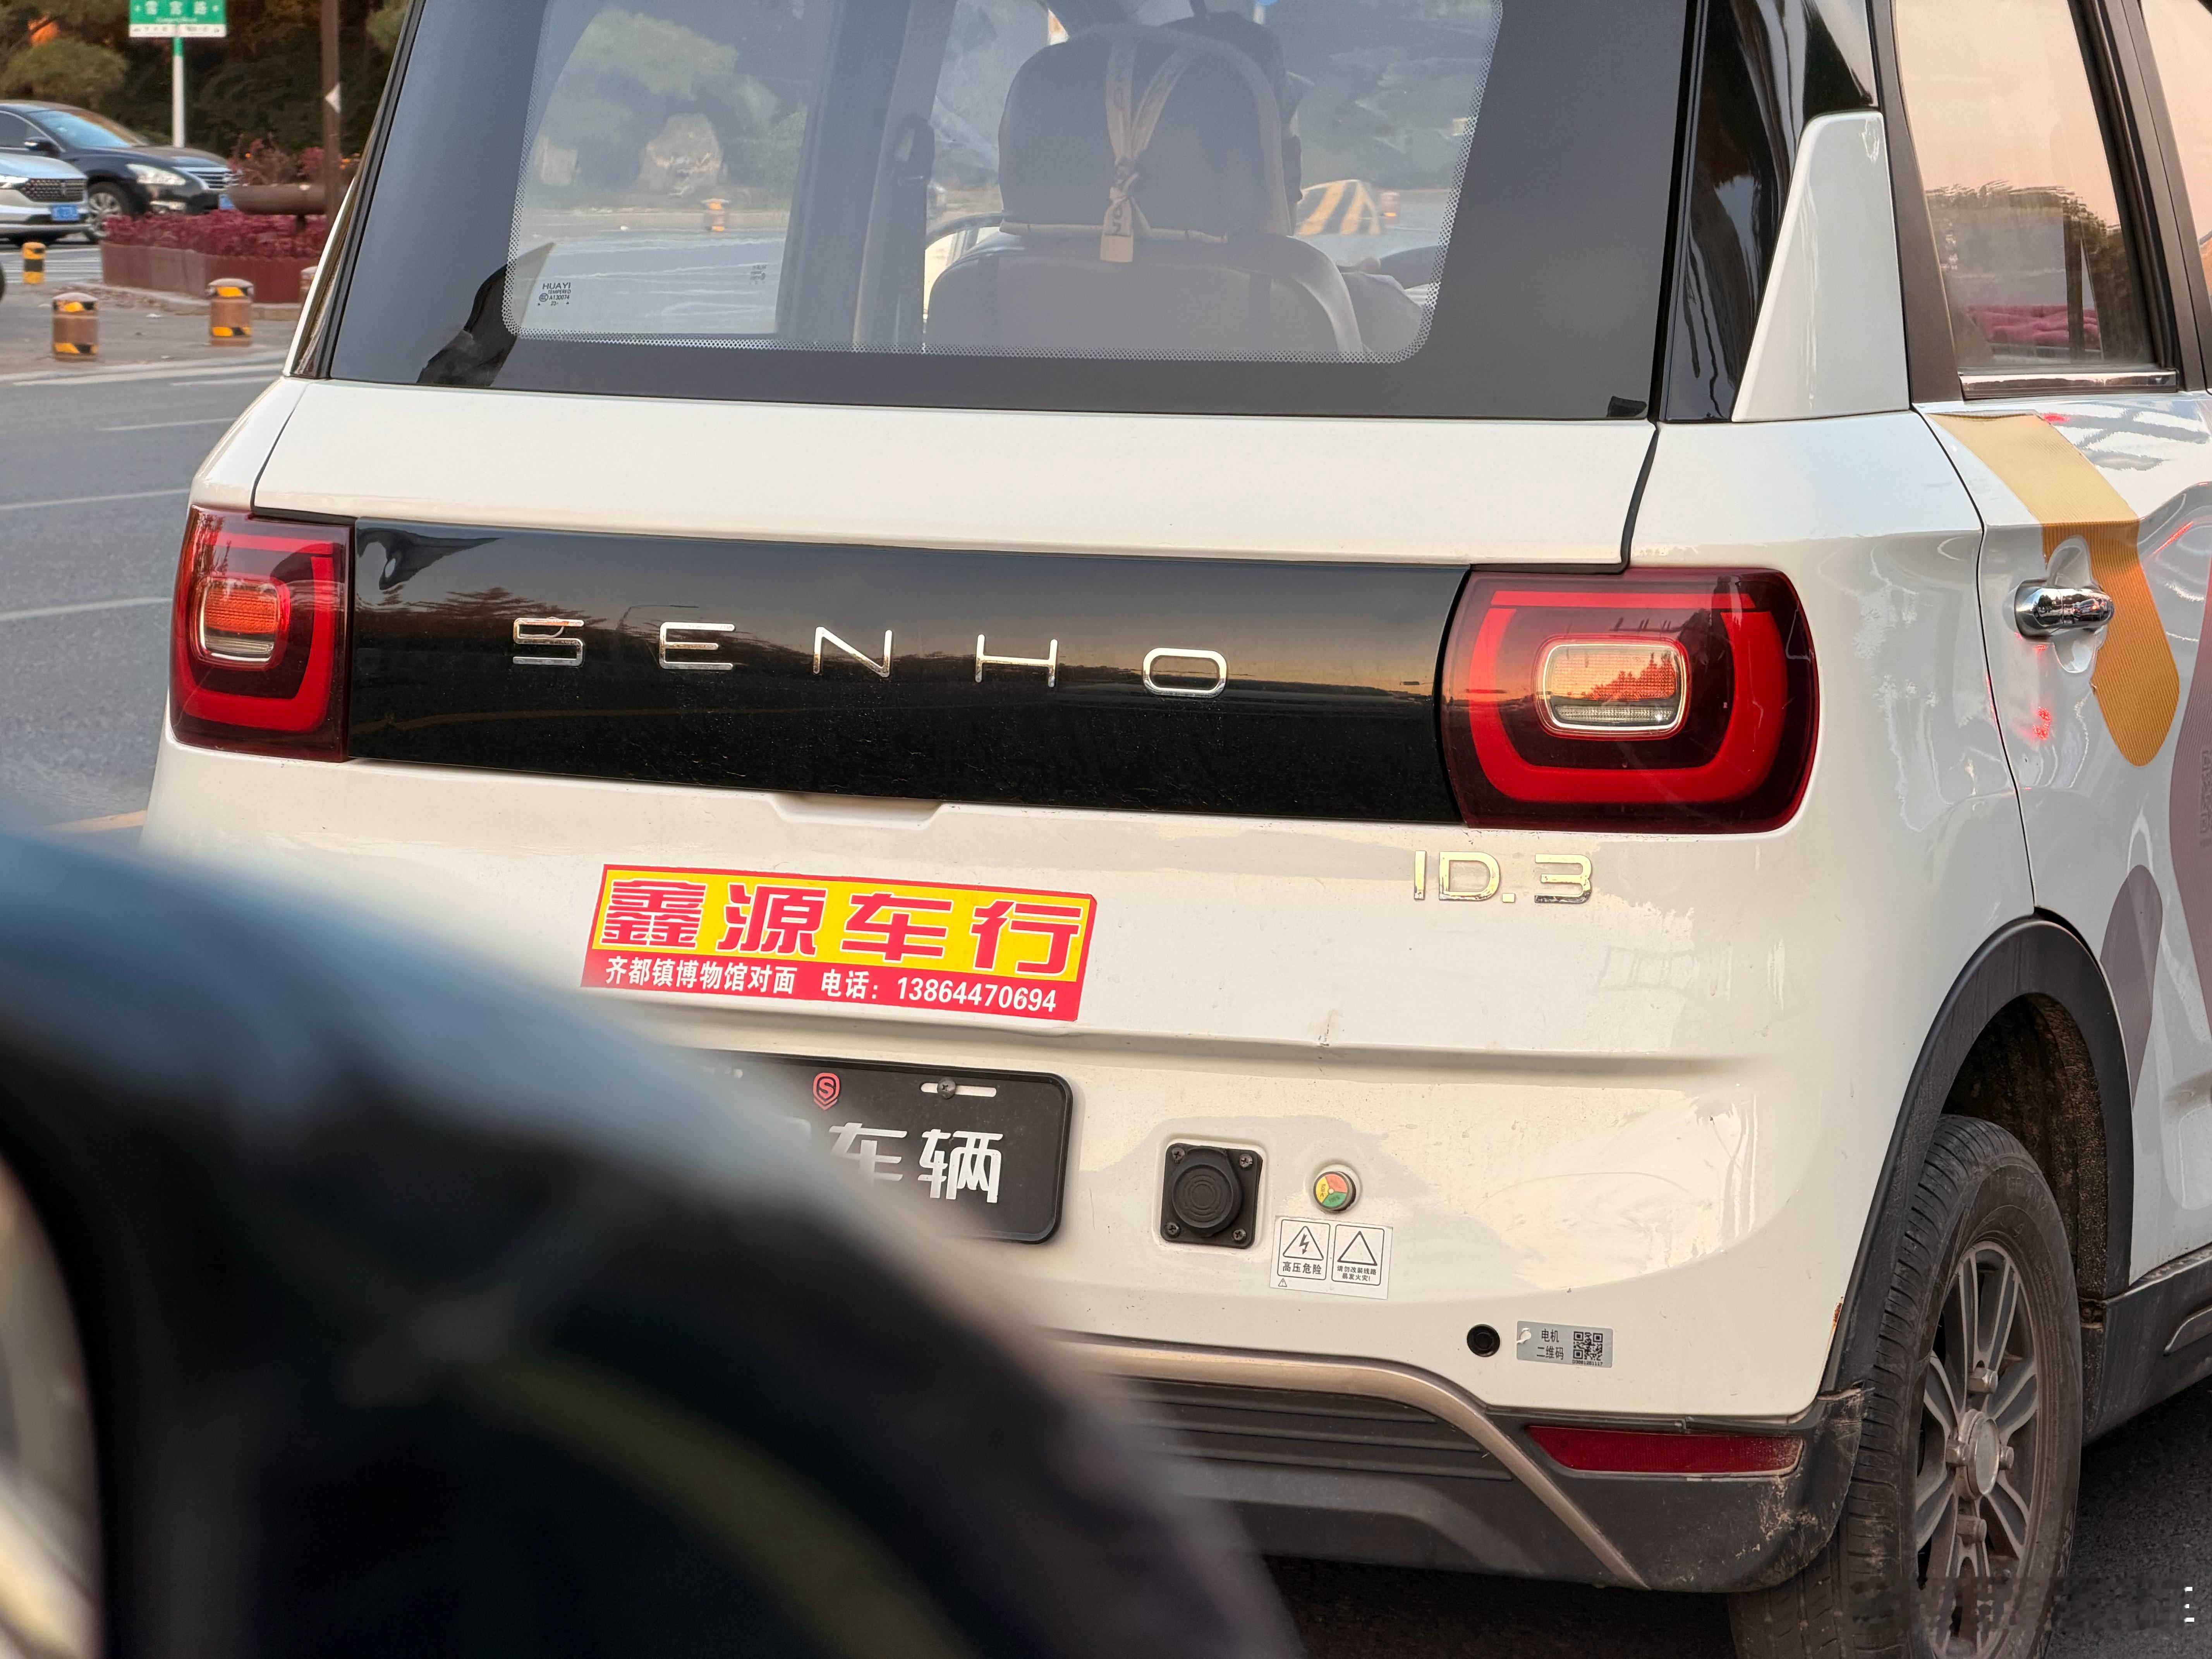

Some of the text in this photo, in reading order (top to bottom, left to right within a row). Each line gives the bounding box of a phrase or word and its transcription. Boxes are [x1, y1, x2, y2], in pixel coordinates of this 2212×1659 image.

[512, 616, 1227, 698] SENHO
[1414, 850, 1592, 905] ID.3
[603, 878, 1083, 977] 鑫源车行
[606, 955, 797, 994] 齐都镇博物馆对面
[897, 977, 1056, 1012] 13864470694
[1283, 1261, 1322, 1275] 高压危险
[1337, 1266, 1376, 1275] 请勿改装线路
[1537, 1346, 1564, 1360] 二维码
[1541, 1329, 1559, 1343] 电机
